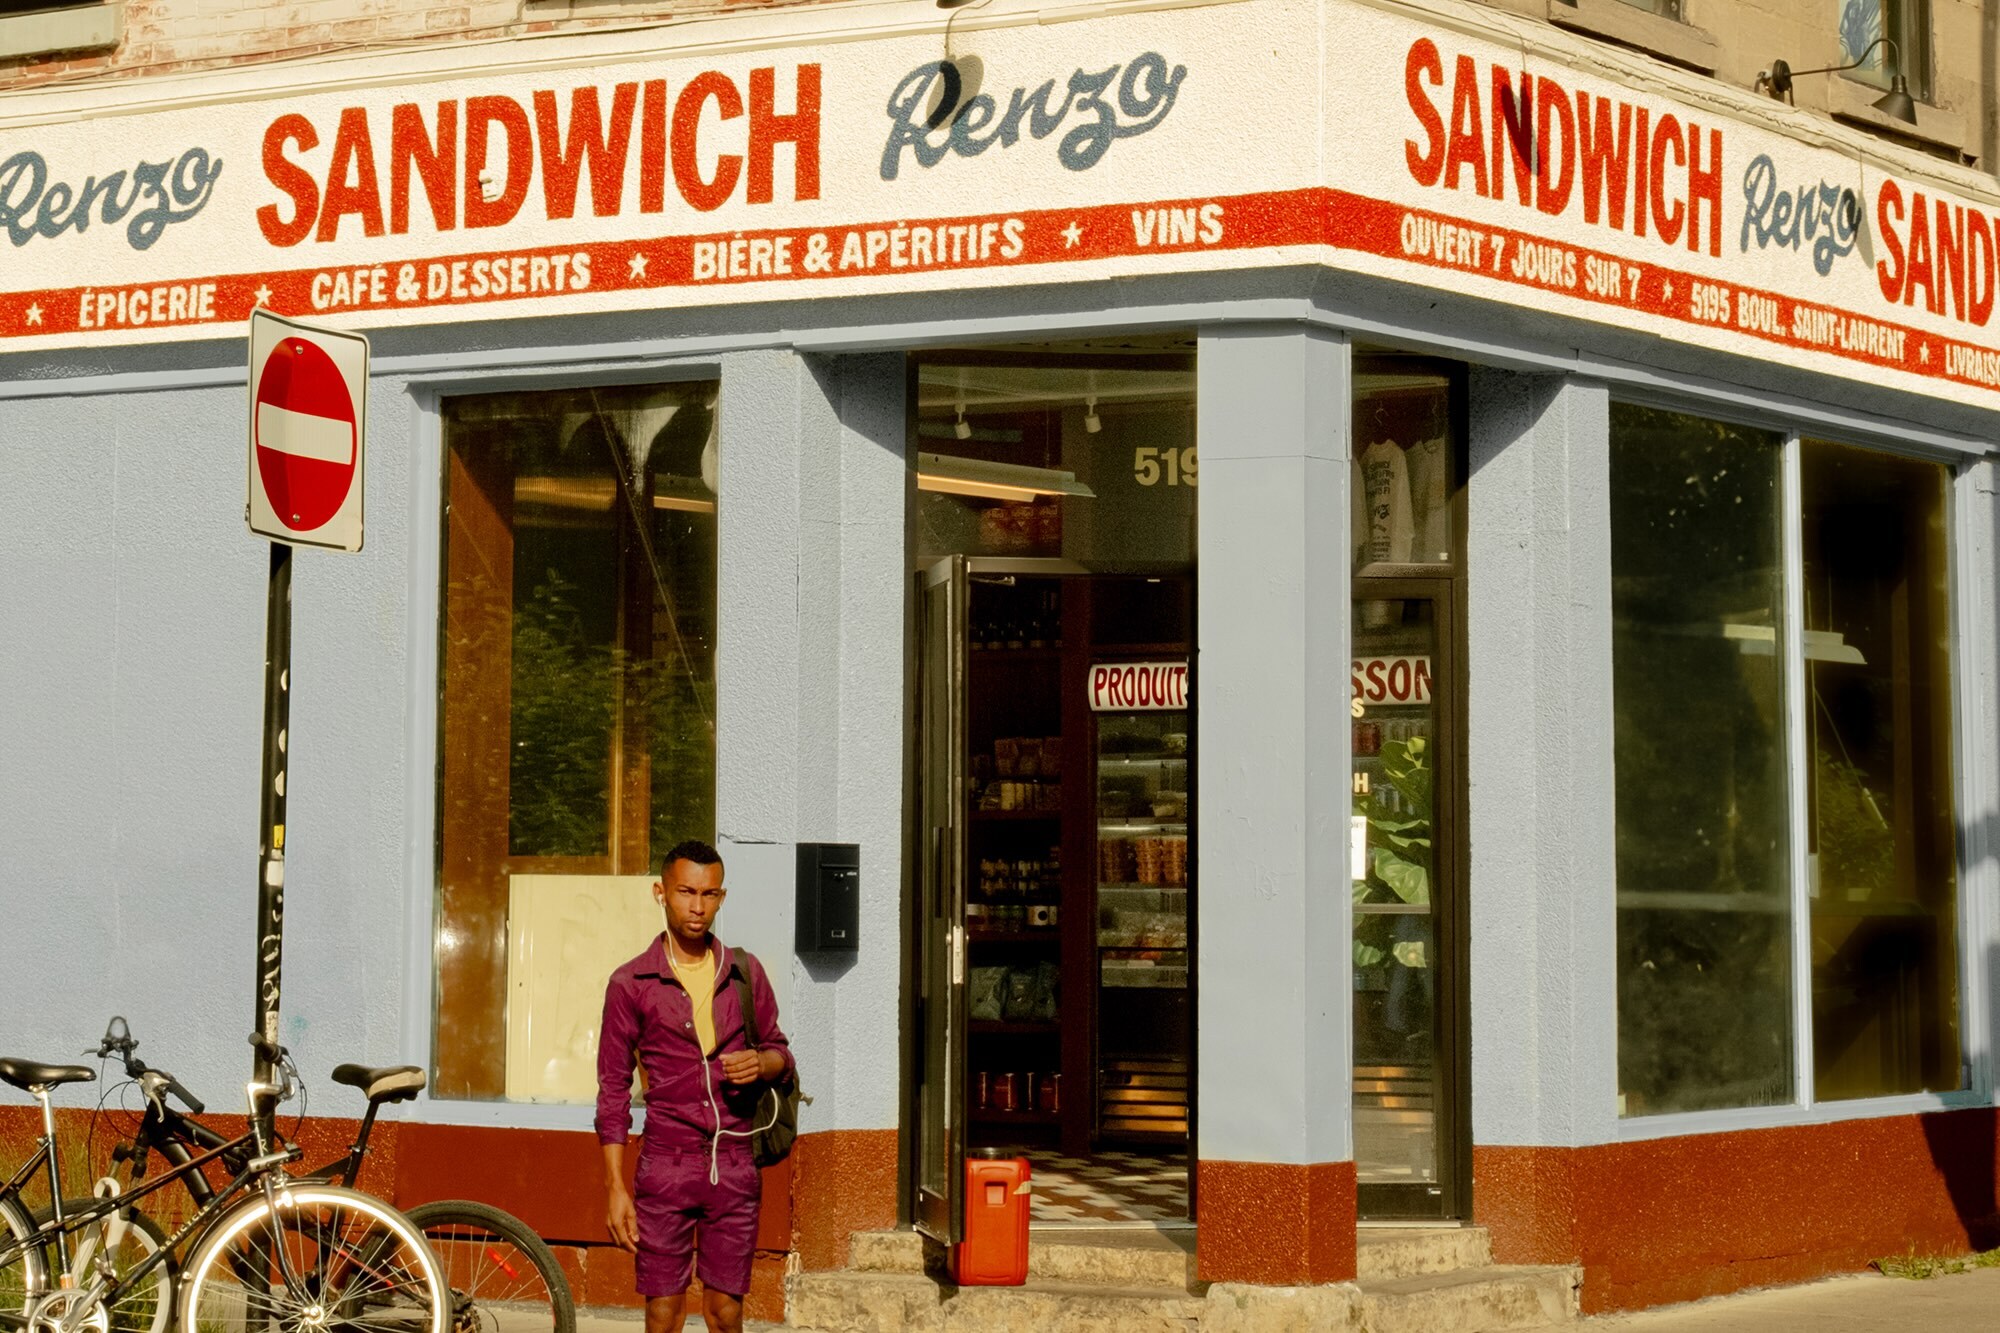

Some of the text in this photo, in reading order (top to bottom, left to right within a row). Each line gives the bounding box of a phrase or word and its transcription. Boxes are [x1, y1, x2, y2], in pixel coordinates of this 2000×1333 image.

[0, 51, 1187, 250] Renzo SANDWICH Renzo
[1404, 37, 2000, 328] SANDWICH Renzo SAND
[79, 288, 217, 328] ÉPICERIE
[311, 263, 388, 310] CAFÉ
[396, 263, 421, 300] &
[427, 252, 591, 300] DESSERTS
[803, 233, 833, 272] &
[839, 218, 1026, 270] APÉRITIFS
[1132, 204, 1224, 248] VINS
[1400, 212, 1484, 268] OUVERT
[1490, 233, 1505, 272] 7
[1510, 238, 1577, 289] JOURS
[1585, 254, 1621, 298] SUR
[1627, 266, 1641, 303] 7
[1691, 282, 1730, 324] 5195
[1738, 292, 1786, 337] BOUL.
[1792, 305, 1906, 363] SAINT-LAURENT
[1094, 666, 1188, 707] PRODUIT
